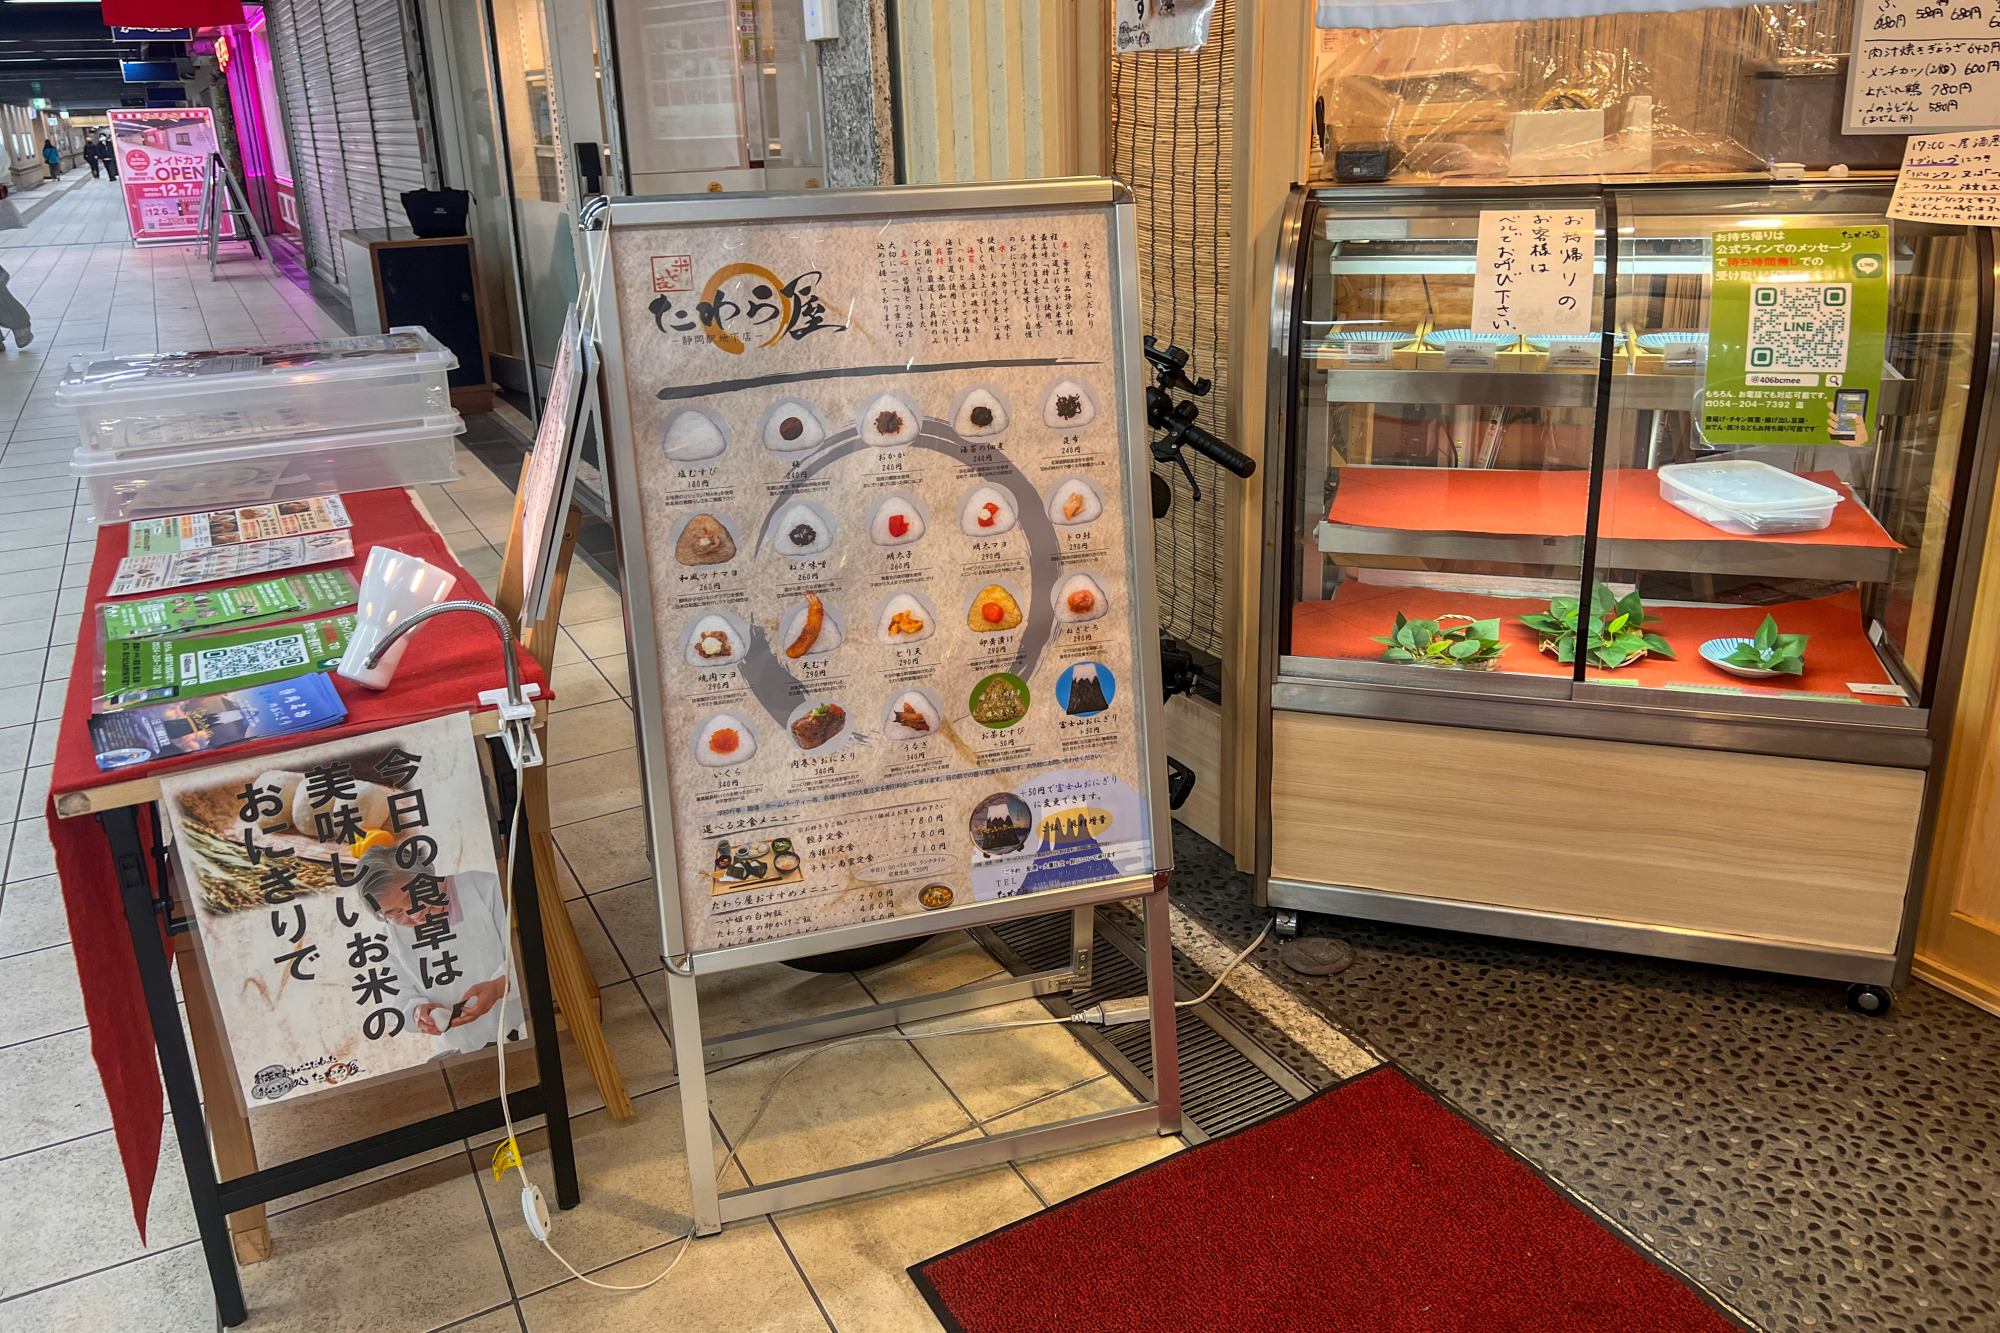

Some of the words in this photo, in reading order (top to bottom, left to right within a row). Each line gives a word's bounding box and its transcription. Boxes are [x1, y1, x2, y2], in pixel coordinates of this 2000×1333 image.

[1916, 7, 1944, 19] 580円
[1950, 6, 1982, 20] 680円
[1965, 60, 2000, 76] 600円
[1931, 82, 1972, 96] 780円
[1929, 99, 1958, 112] 580円
[153, 156, 206, 166] メイドカフ
[155, 166, 206, 181] OPEN
[1715, 231, 1785, 242] お持ち帰りは
[1530, 215, 1552, 273] お客様は
[1716, 242, 1852, 254] 公式ラインでのメッセージ
[1716, 256, 1824, 267] で待ち時間無しでの
[1083, 241, 1095, 329] たわら屋のこだわり
[648, 271, 848, 341] たわら屋
[1782, 321, 1813, 333] LINE
[1751, 376, 1801, 384] @406bcmee
[1706, 390, 1828, 400] もちろん、お電話でも対応可能です。
[1063, 435, 1079, 445] 昆布
[1061, 446, 1081, 454] 240円
[878, 452, 906, 461] おかか
[973, 455, 993, 463] 240円
[677, 467, 717, 478] 塩むすび
[882, 464, 903, 472] 240円
[787, 471, 808, 479] 240円
[688, 480, 709, 488] 180円
[1066, 532, 1092, 541] トロ鮭
[972, 541, 1007, 551] 明太マヨ
[1069, 542, 1088, 551] 290円
[886, 551, 913, 560] 明太子
[981, 552, 1001, 560] 290円
[789, 560, 827, 571] ねぎ味噌
[890, 562, 911, 570] 260円
[679, 569, 738, 582] 和風ツナマヨ
[798, 573, 819, 581] 260円
[699, 582, 721, 591] 260円
[1066, 625, 1099, 636] ねぎとろ
[979, 635, 1014, 646] 卵黄漬け
[1073, 634, 1092, 642] 290円
[896, 647, 922, 658] とり天
[987, 646, 1007, 654] 290円
[802, 659, 829, 670] 天むす
[899, 658, 919, 666] 290円
[698, 671, 736, 683] 焼肉マヨ
[806, 670, 826, 678] 290円
[708, 682, 729, 690] 290円
[1059, 714, 1118, 729] 富士山おにぎり
[981, 728, 1024, 740] お茶むすび
[903, 741, 928, 752] うなぎ
[790, 752, 856, 769] 肉巻きおにぎり
[906, 753, 925, 761] 340円
[714, 768, 741, 779] いくら
[815, 767, 835, 775] 340円
[718, 780, 739, 789] 340円
[1034, 792, 1102, 808] に変更できます。
[702, 813, 800, 834] 選べる定食メニュー
[806, 831, 844, 845] 餃子定食
[808, 842, 855, 858] 唐揚げ定食
[373, 748, 464, 990] 今日の食卓は
[810, 854, 875, 873] チキン南蛮定食
[237, 782, 321, 981] おにぎりで
[996, 879, 1017, 888] TEL
[711, 884, 839, 911] たわら屋おすすめメニュー
[860, 888, 894, 902] 290円
[305, 762, 406, 1041] 美味しいお米の
[716, 916, 812, 938] たわら屋の卵かけご飯
[860, 900, 895, 913] 480円
